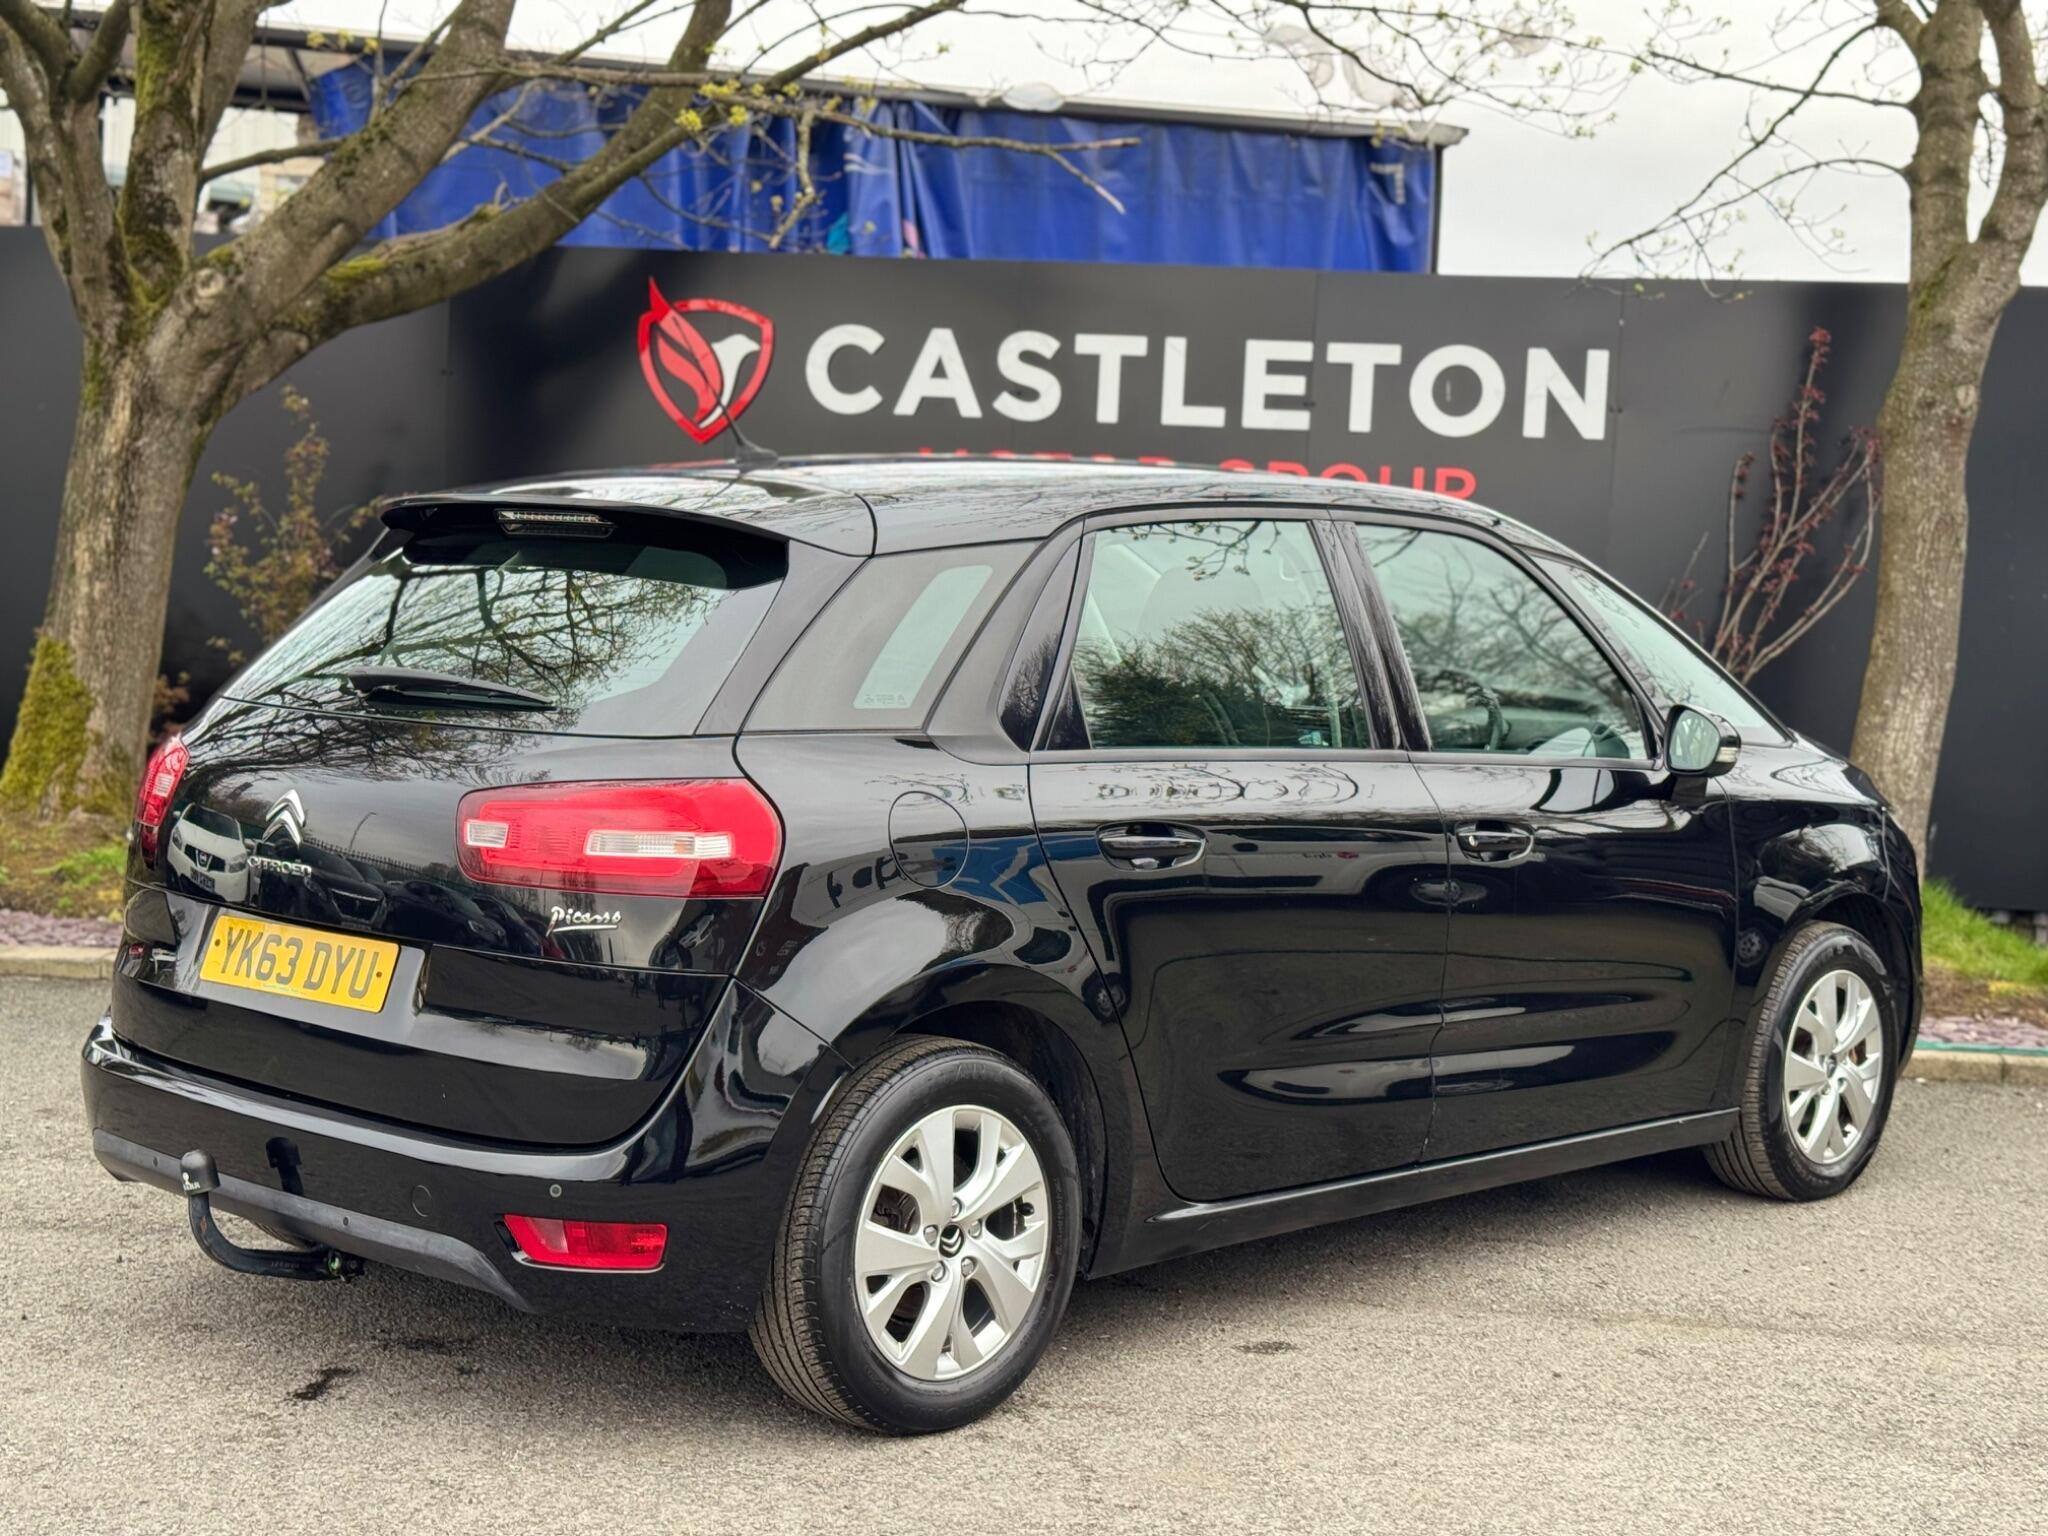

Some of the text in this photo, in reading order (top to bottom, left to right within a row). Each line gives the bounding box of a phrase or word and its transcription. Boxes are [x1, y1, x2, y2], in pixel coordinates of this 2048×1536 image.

[805, 324, 1610, 441] CASTLETON
[546, 906, 621, 937] Picasso
[220, 926, 380, 1000] YK63 DYU
